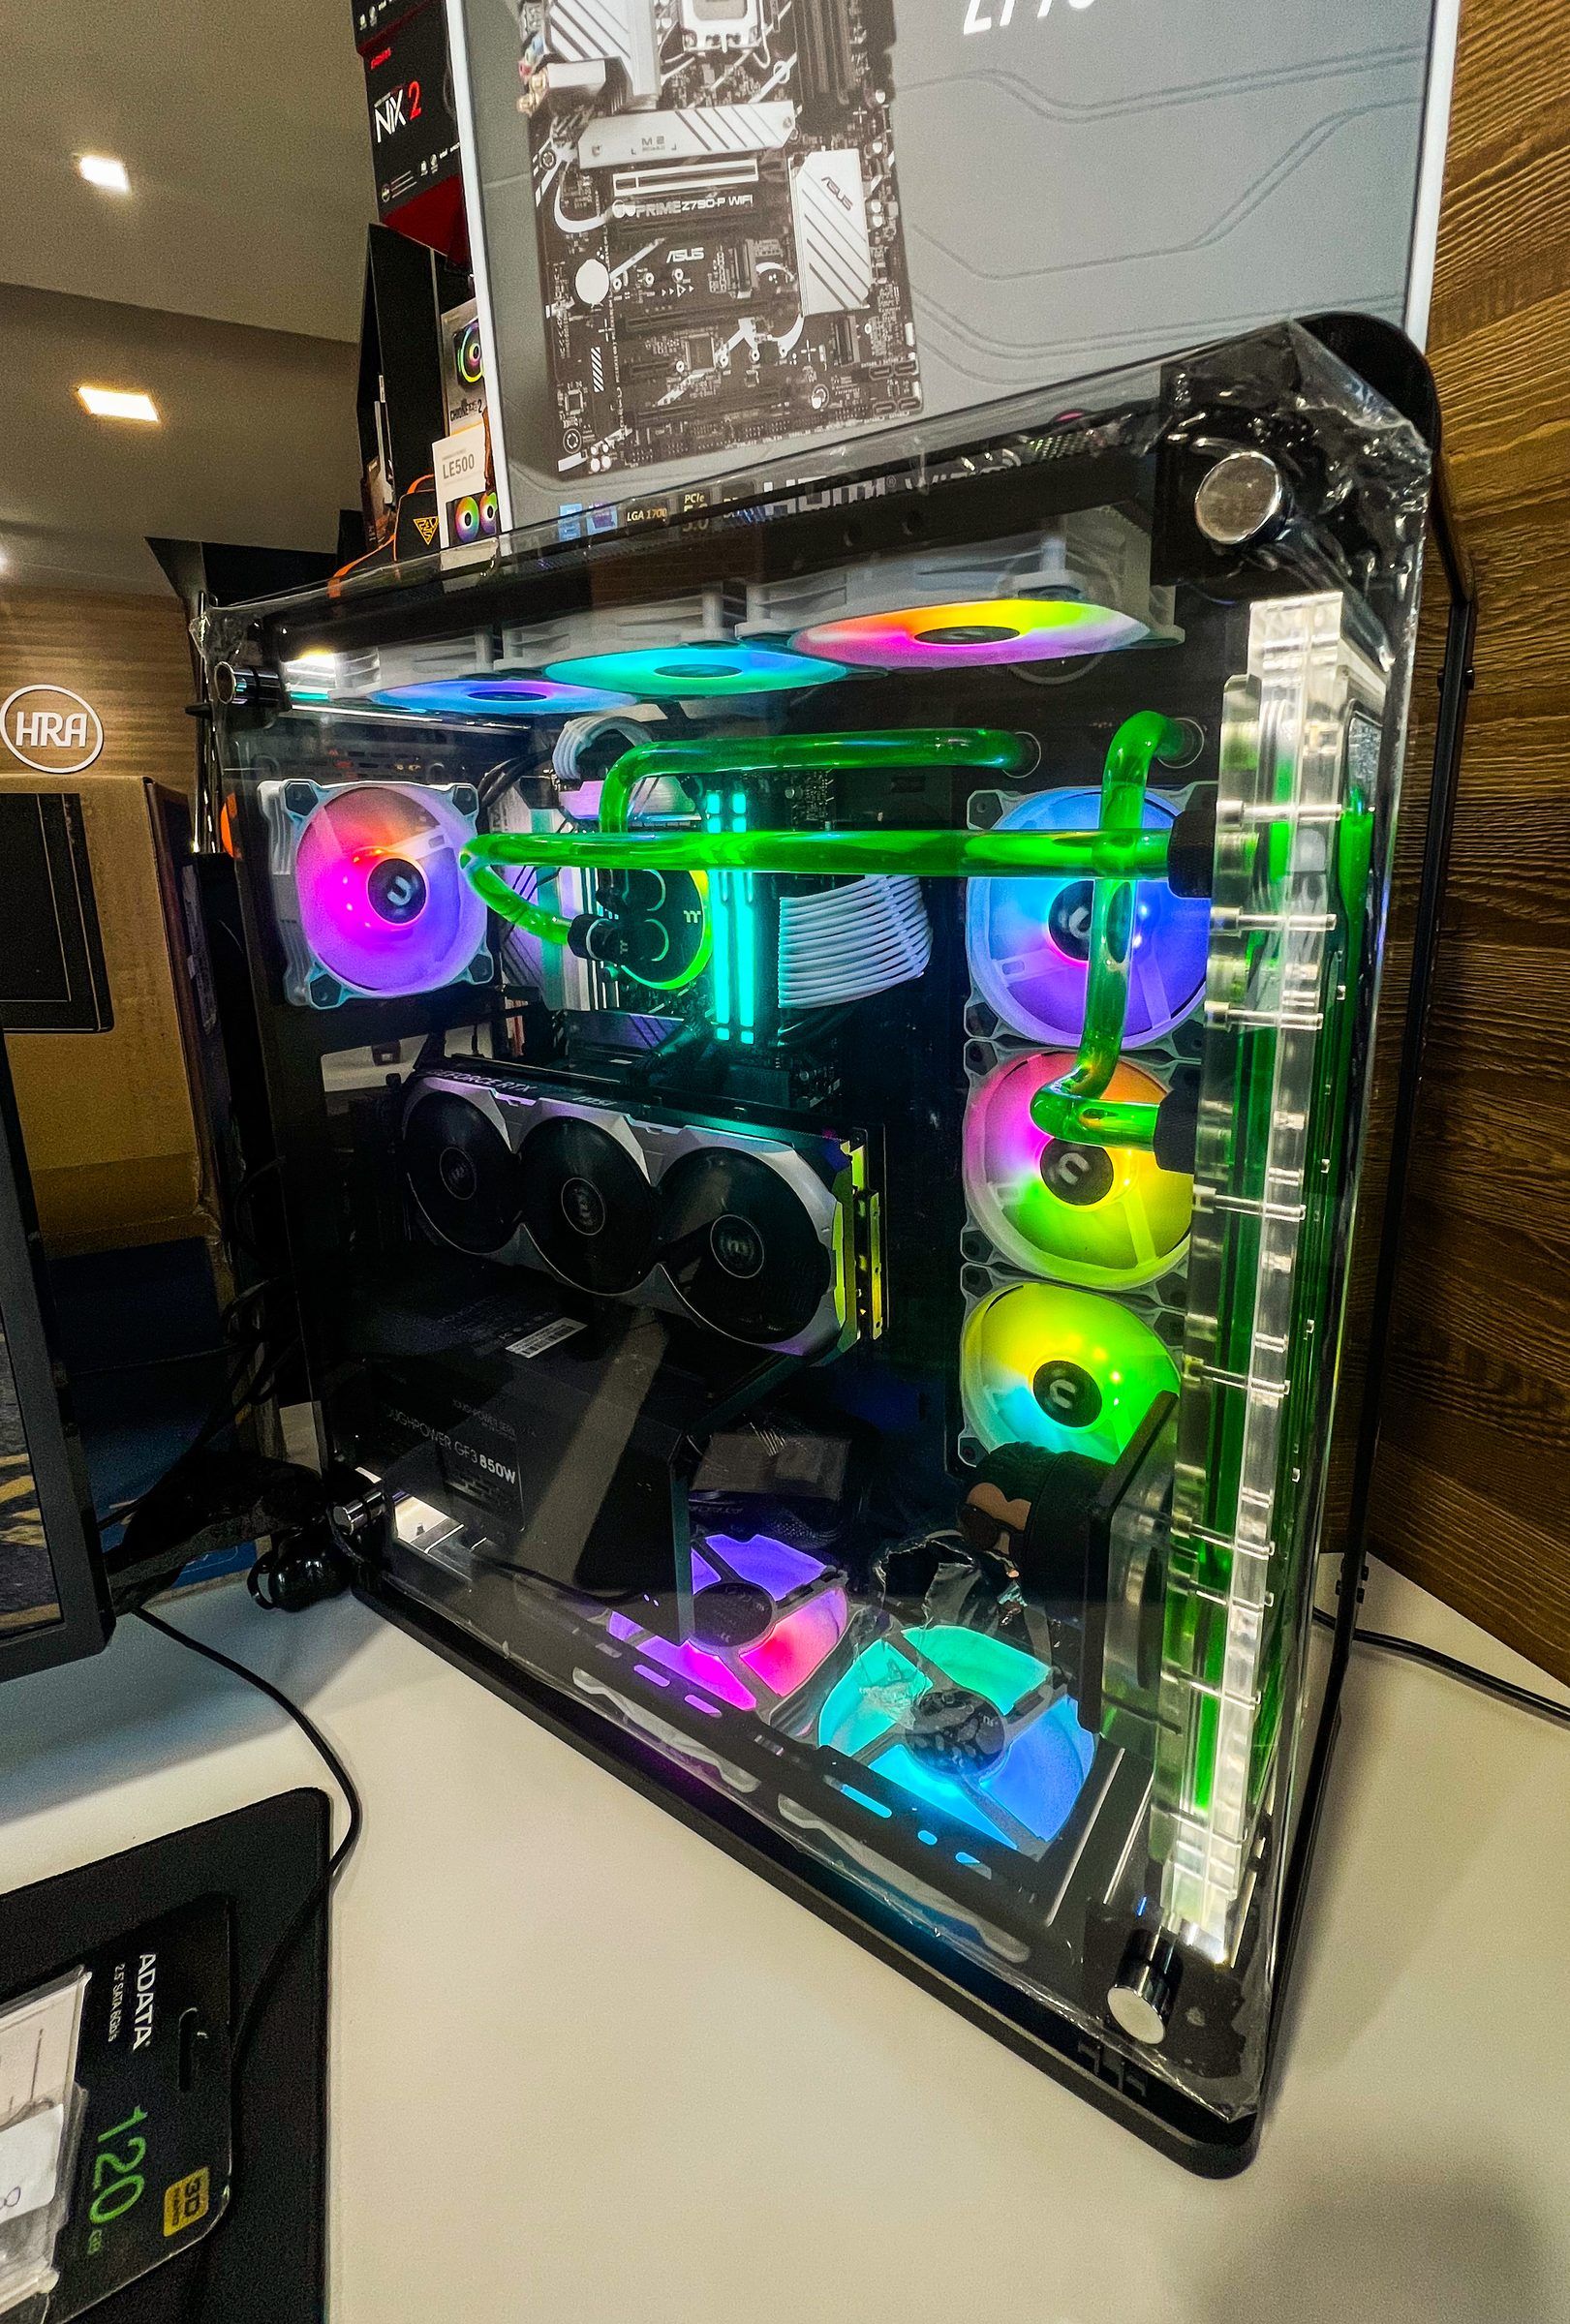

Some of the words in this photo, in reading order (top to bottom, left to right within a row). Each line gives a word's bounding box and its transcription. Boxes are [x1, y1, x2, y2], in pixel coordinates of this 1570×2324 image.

[408, 81, 422, 120] 2
[666, 247, 705, 263] ASUS
[443, 453, 476, 479] LE500
[627, 509, 644, 522] LGA
[646, 507, 667, 520] 1700
[15, 711, 88, 749] HRA
[479, 1453, 516, 1484] 850W
[132, 1953, 157, 2052] ADATA
[89, 2105, 148, 2223] 120
[185, 2179, 201, 2217] 3D
